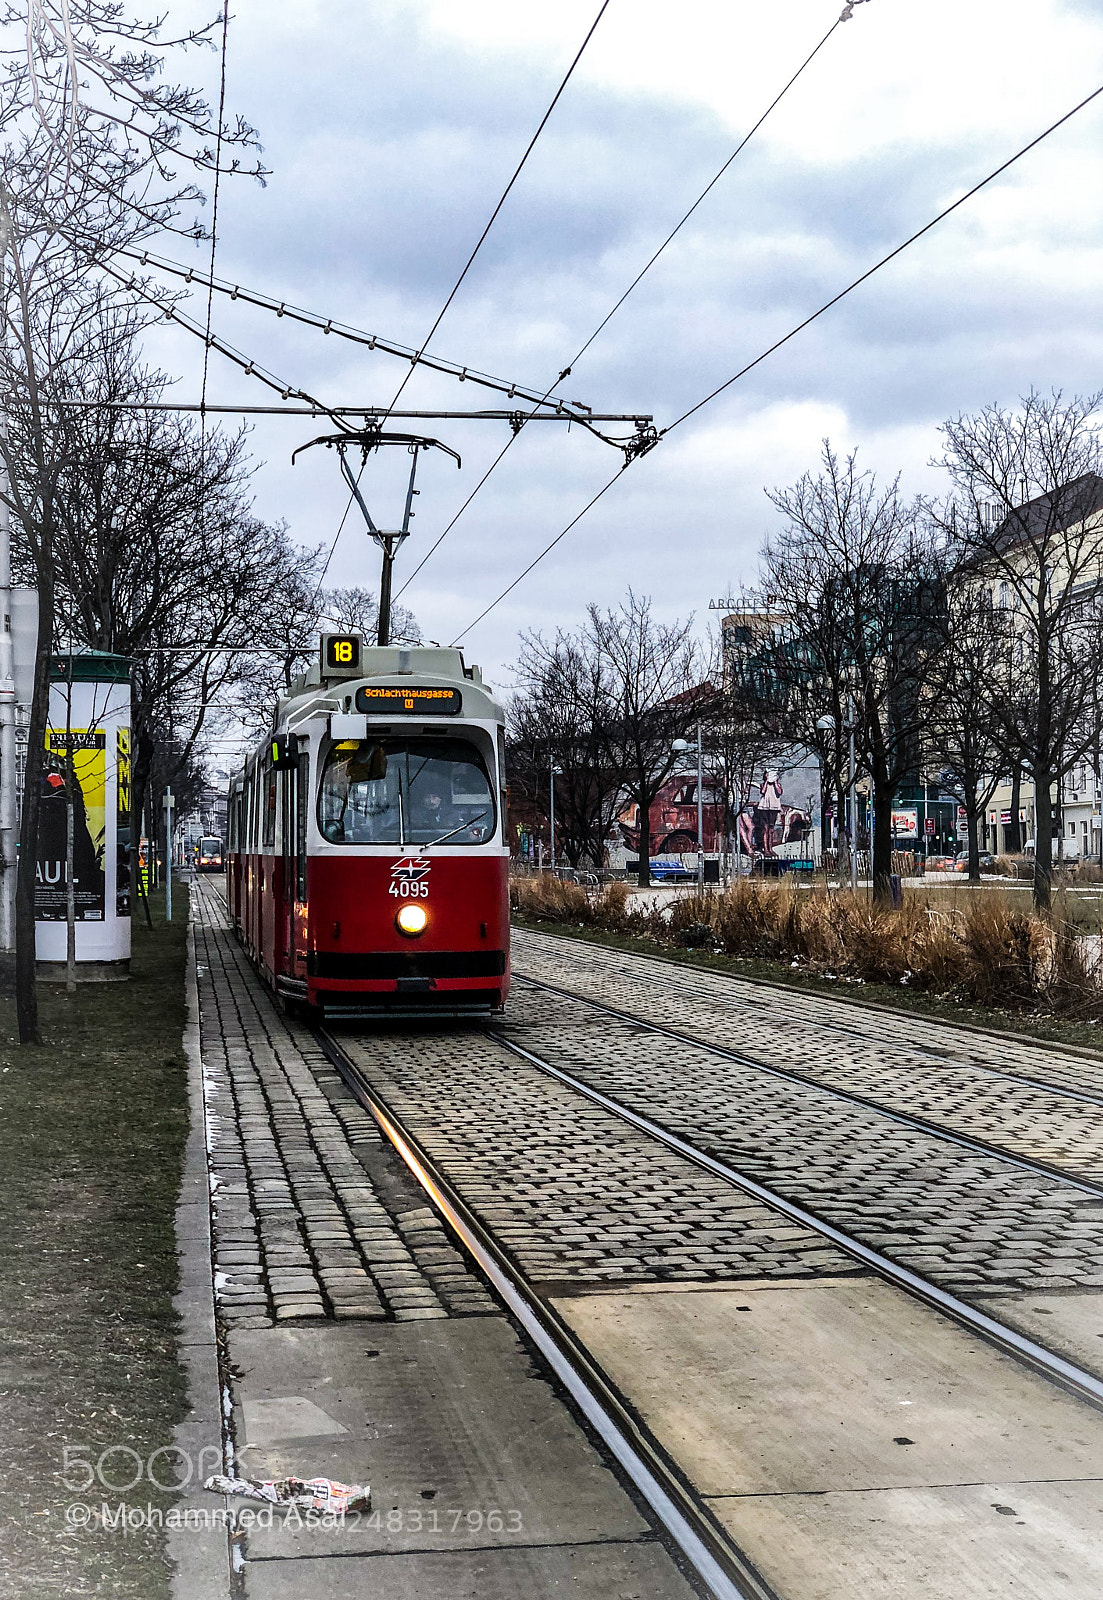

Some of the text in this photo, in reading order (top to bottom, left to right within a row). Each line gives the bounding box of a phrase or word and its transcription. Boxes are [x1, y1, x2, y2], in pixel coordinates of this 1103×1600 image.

[334, 641, 353, 662] 18
[365, 688, 454, 698] Schlachthausgasse
[388, 881, 429, 898] 4095
